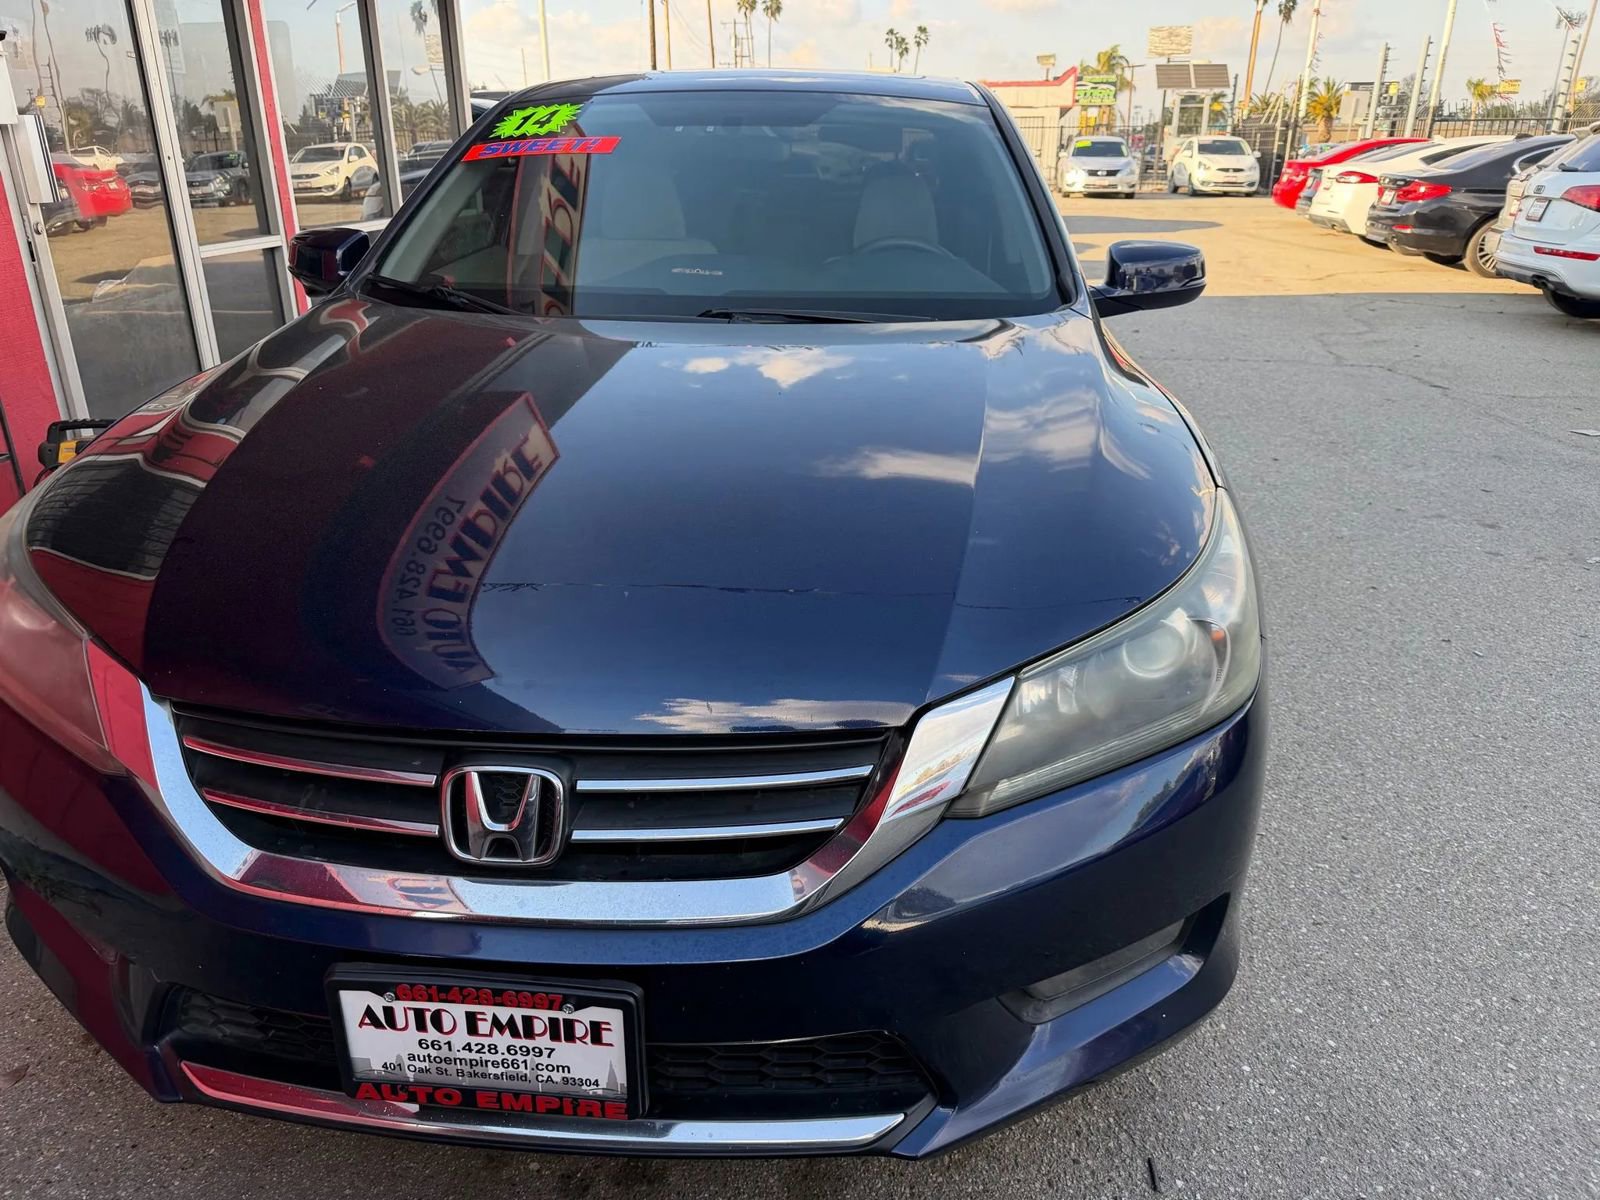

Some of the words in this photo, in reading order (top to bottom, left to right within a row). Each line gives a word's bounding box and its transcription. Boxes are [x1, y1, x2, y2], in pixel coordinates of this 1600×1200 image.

[512, 109, 560, 131] 14
[479, 138, 601, 157] SWEET!
[396, 983, 564, 1012] 661-428-6997
[358, 1004, 458, 1036] AUTO
[464, 1010, 615, 1048] EMPIRE
[417, 1037, 556, 1059] 661.428.6997
[381, 1061, 403, 1073] 401
[407, 1063, 432, 1075] Oak
[435, 1066, 453, 1077] St.
[456, 1068, 533, 1084] Bakersfield,
[535, 1074, 559, 1085] CA.
[561, 1076, 600, 1089] 93304
[407, 1052, 572, 1075] autoempire661.com
[354, 1082, 463, 1107] AUTO
[475, 1089, 629, 1121] EMPIRE
